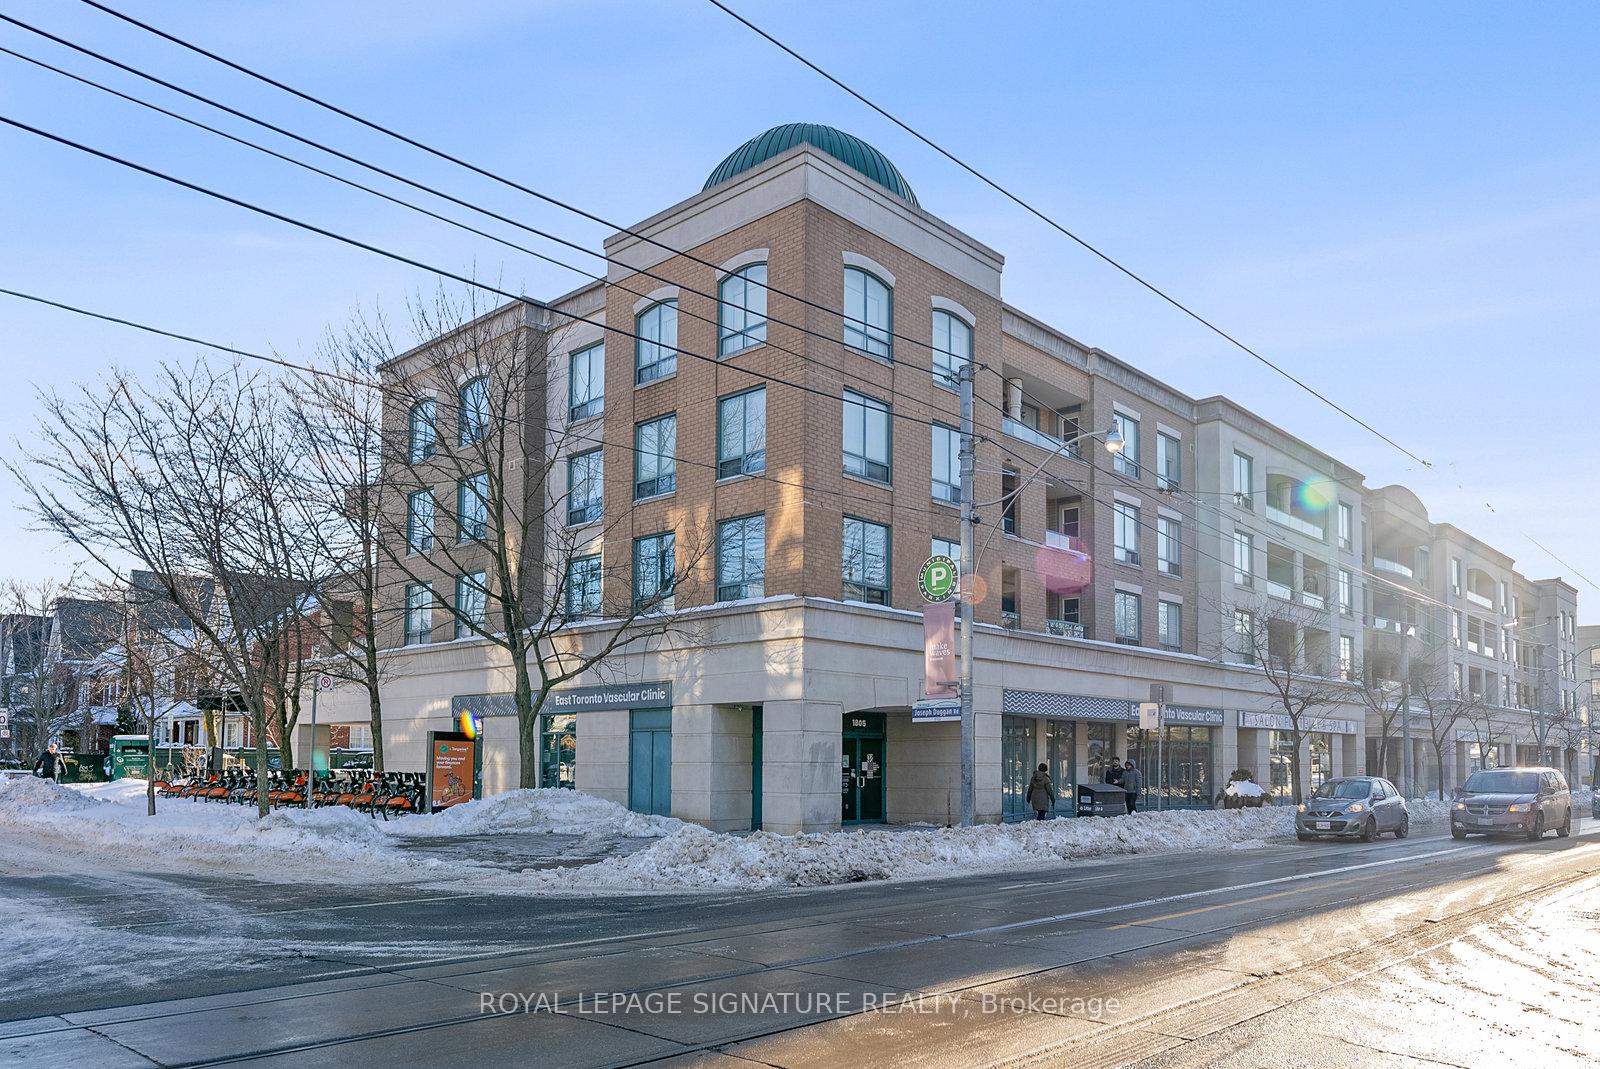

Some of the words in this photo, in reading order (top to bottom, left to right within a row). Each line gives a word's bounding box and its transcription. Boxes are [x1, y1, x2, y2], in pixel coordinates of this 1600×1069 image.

[920, 556, 957, 580] MUNICIPAL
[931, 567, 947, 587] P
[555, 695, 571, 706] East
[571, 694, 602, 705] Toronto
[603, 690, 640, 703] Vascular
[640, 688, 666, 701] Clinic
[914, 708, 932, 717] Joseph
[933, 708, 952, 717] Duggan
[1176, 708, 1205, 721] Vascular
[1205, 710, 1223, 722] Clinic
[1254, 714, 1281, 728] SALON
